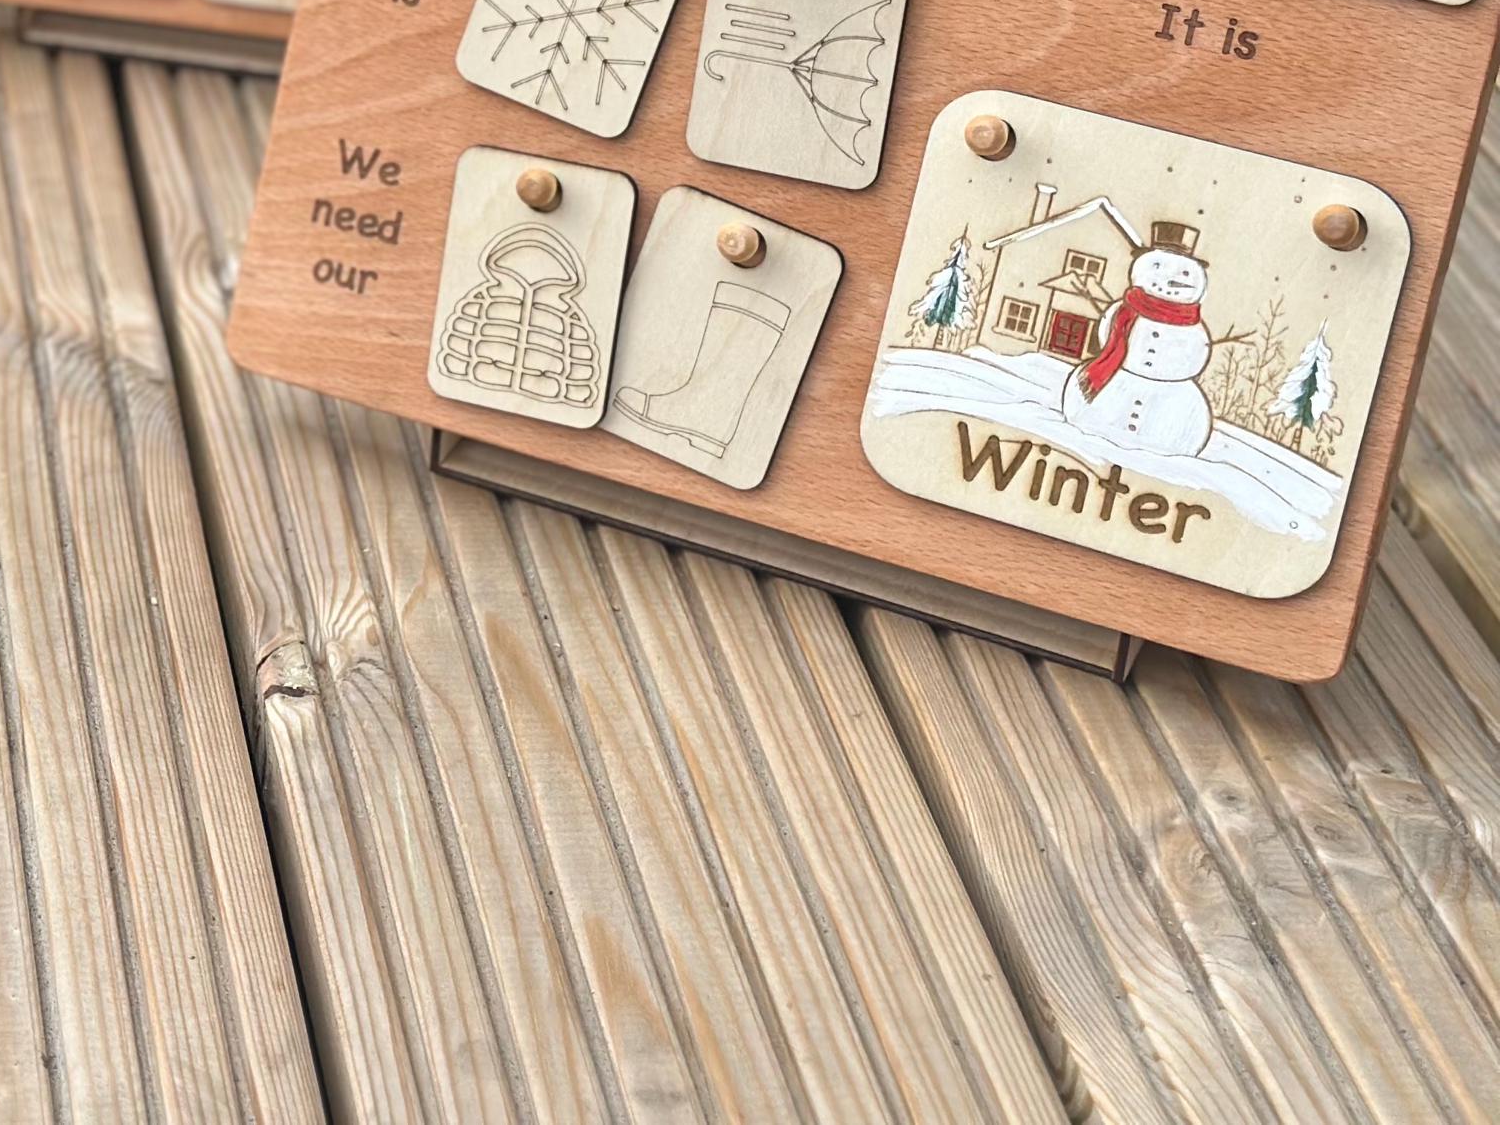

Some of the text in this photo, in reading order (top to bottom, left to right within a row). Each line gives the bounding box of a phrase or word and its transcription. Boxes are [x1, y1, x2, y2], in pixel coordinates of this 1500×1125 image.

[1154, 2, 1260, 60] It is
[337, 137, 402, 186] We
[310, 197, 403, 246] need
[312, 255, 380, 297] our
[957, 421, 1211, 544] Winter
